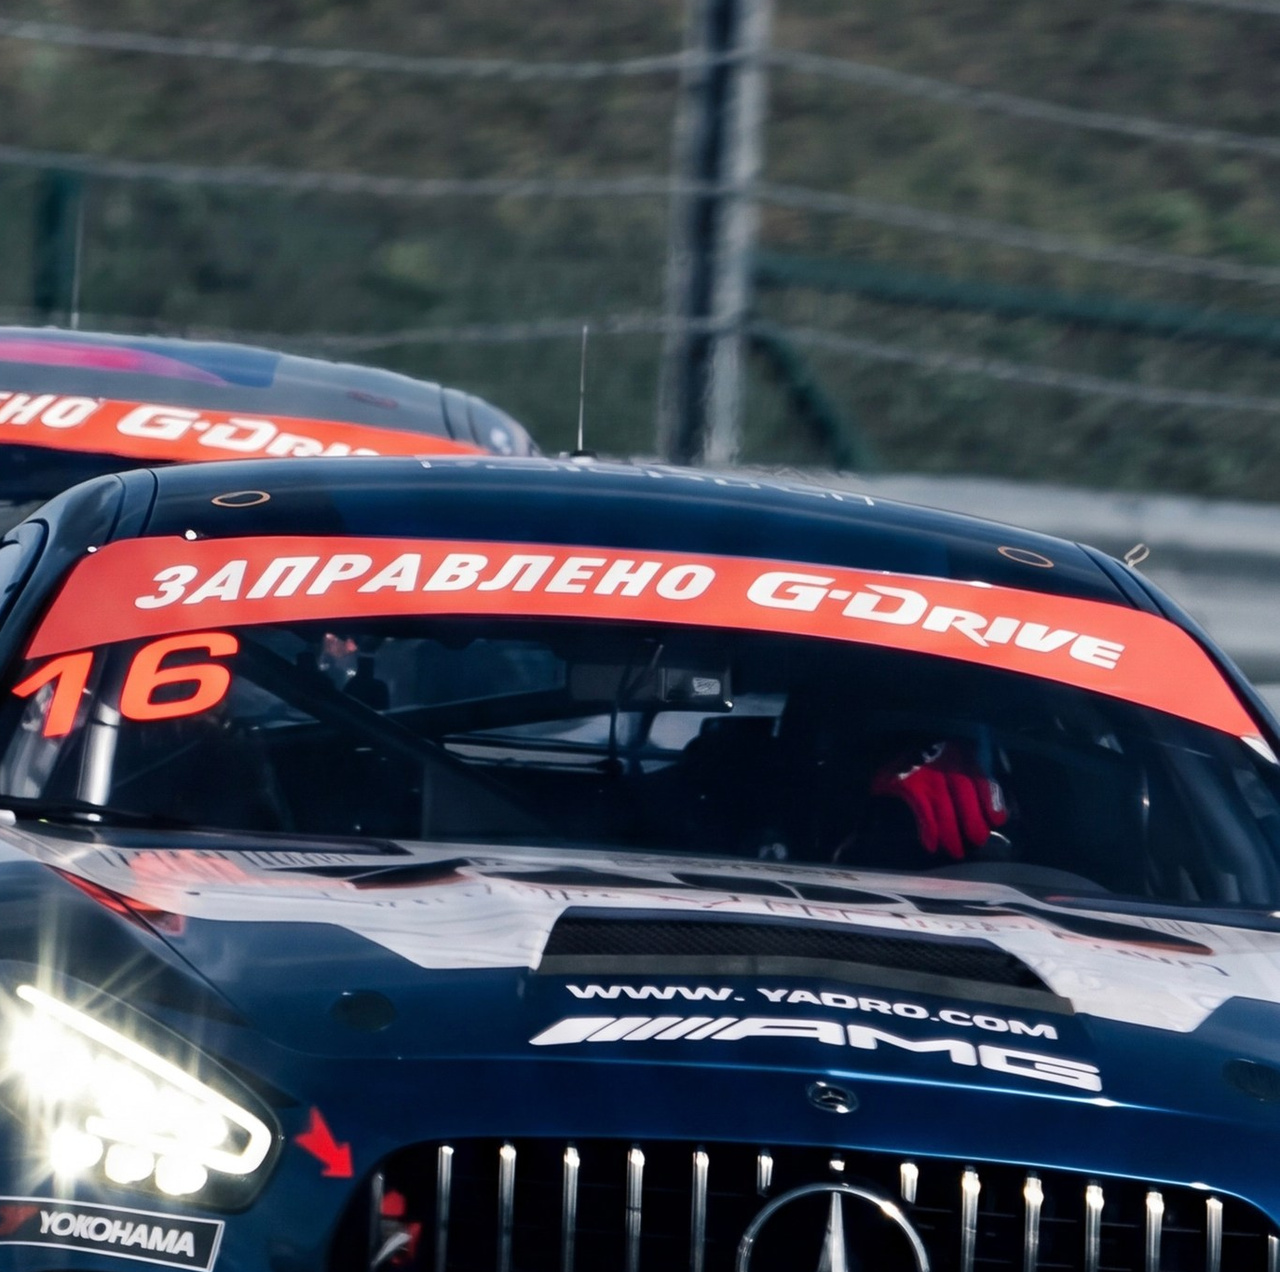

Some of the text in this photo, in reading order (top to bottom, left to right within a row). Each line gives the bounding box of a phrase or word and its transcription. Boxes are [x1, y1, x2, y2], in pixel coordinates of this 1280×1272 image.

[134, 552, 716, 610] ЗАПРАВЛЕНО
[12, 632, 240, 739] 16
[710, 1017, 1103, 1092] AMG
[38, 1209, 196, 1258] YOKOHAMA
